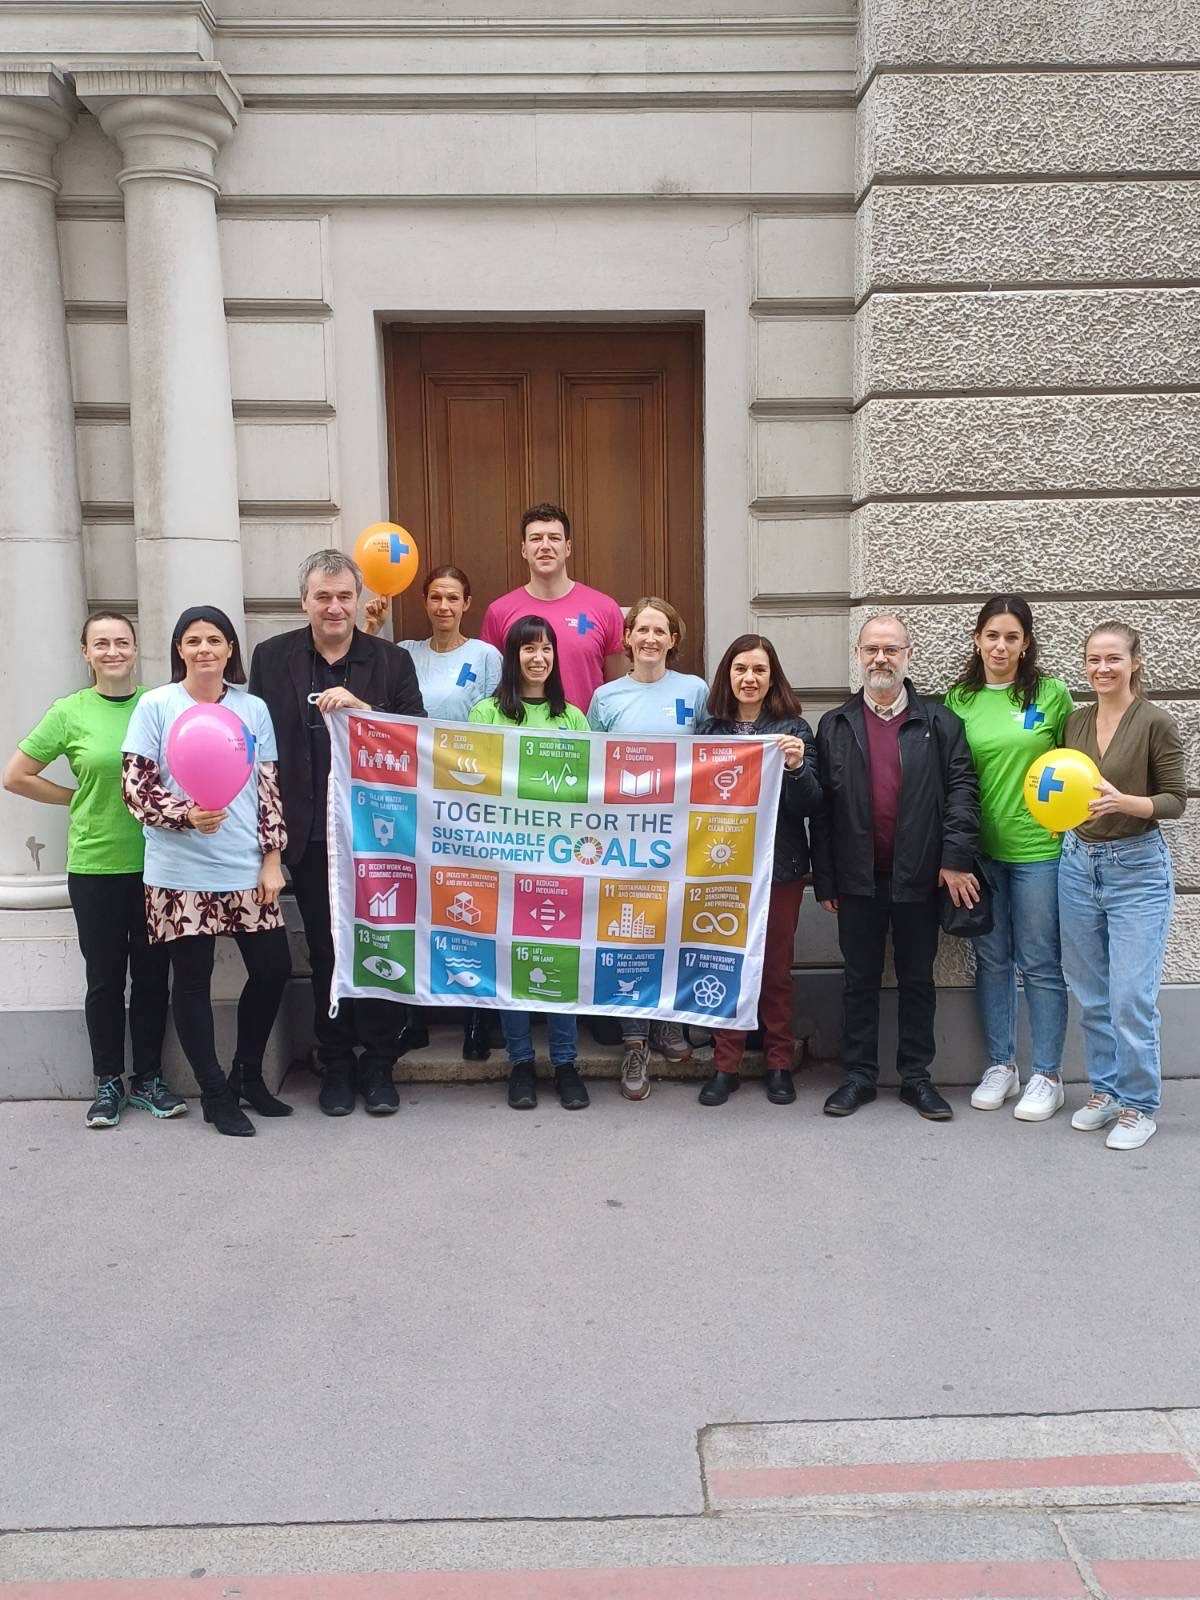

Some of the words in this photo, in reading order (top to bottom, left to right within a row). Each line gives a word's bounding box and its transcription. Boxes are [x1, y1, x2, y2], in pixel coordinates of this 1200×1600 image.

[356, 721, 362, 736] 1
[439, 733, 448, 749] 2
[526, 741, 534, 756] 3
[613, 746, 621, 760] 4
[625, 746, 648, 754] QUALITY
[699, 748, 707, 762] 5
[625, 754, 654, 762] EDUCATION
[357, 791, 366, 806] 6
[432, 800, 562, 828] TOGETHER
[570, 812, 618, 831] FOR
[626, 813, 674, 834] THE
[695, 816, 703, 831] 7
[432, 826, 545, 847] SUSTAINABLE
[431, 841, 545, 863] DEVELOPMENT
[549, 834, 673, 869] GOALS
[358, 863, 366, 878] 8
[368, 863, 386, 871] DECENT
[386, 863, 402, 871] WORK
[392, 872, 413, 880] GROWTH
[435, 871, 444, 886] 9
[535, 879, 559, 887] REDUCED
[519, 878, 533, 893] 10
[535, 887, 568, 896] INEQUALITIES
[604, 883, 615, 898] 11
[690, 887, 702, 902] 12
[358, 929, 370, 943] 13
[434, 935, 448, 950] 14
[516, 946, 529, 961] 15
[532, 946, 544, 954] LIFE
[600, 952, 614, 967] 16
[684, 952, 697, 967] 17
[699, 961, 710, 969] FOR
[710, 962, 719, 970] THE
[719, 963, 735, 972] GOALS
[700, 953, 736, 965] PARTNERSHIPS
